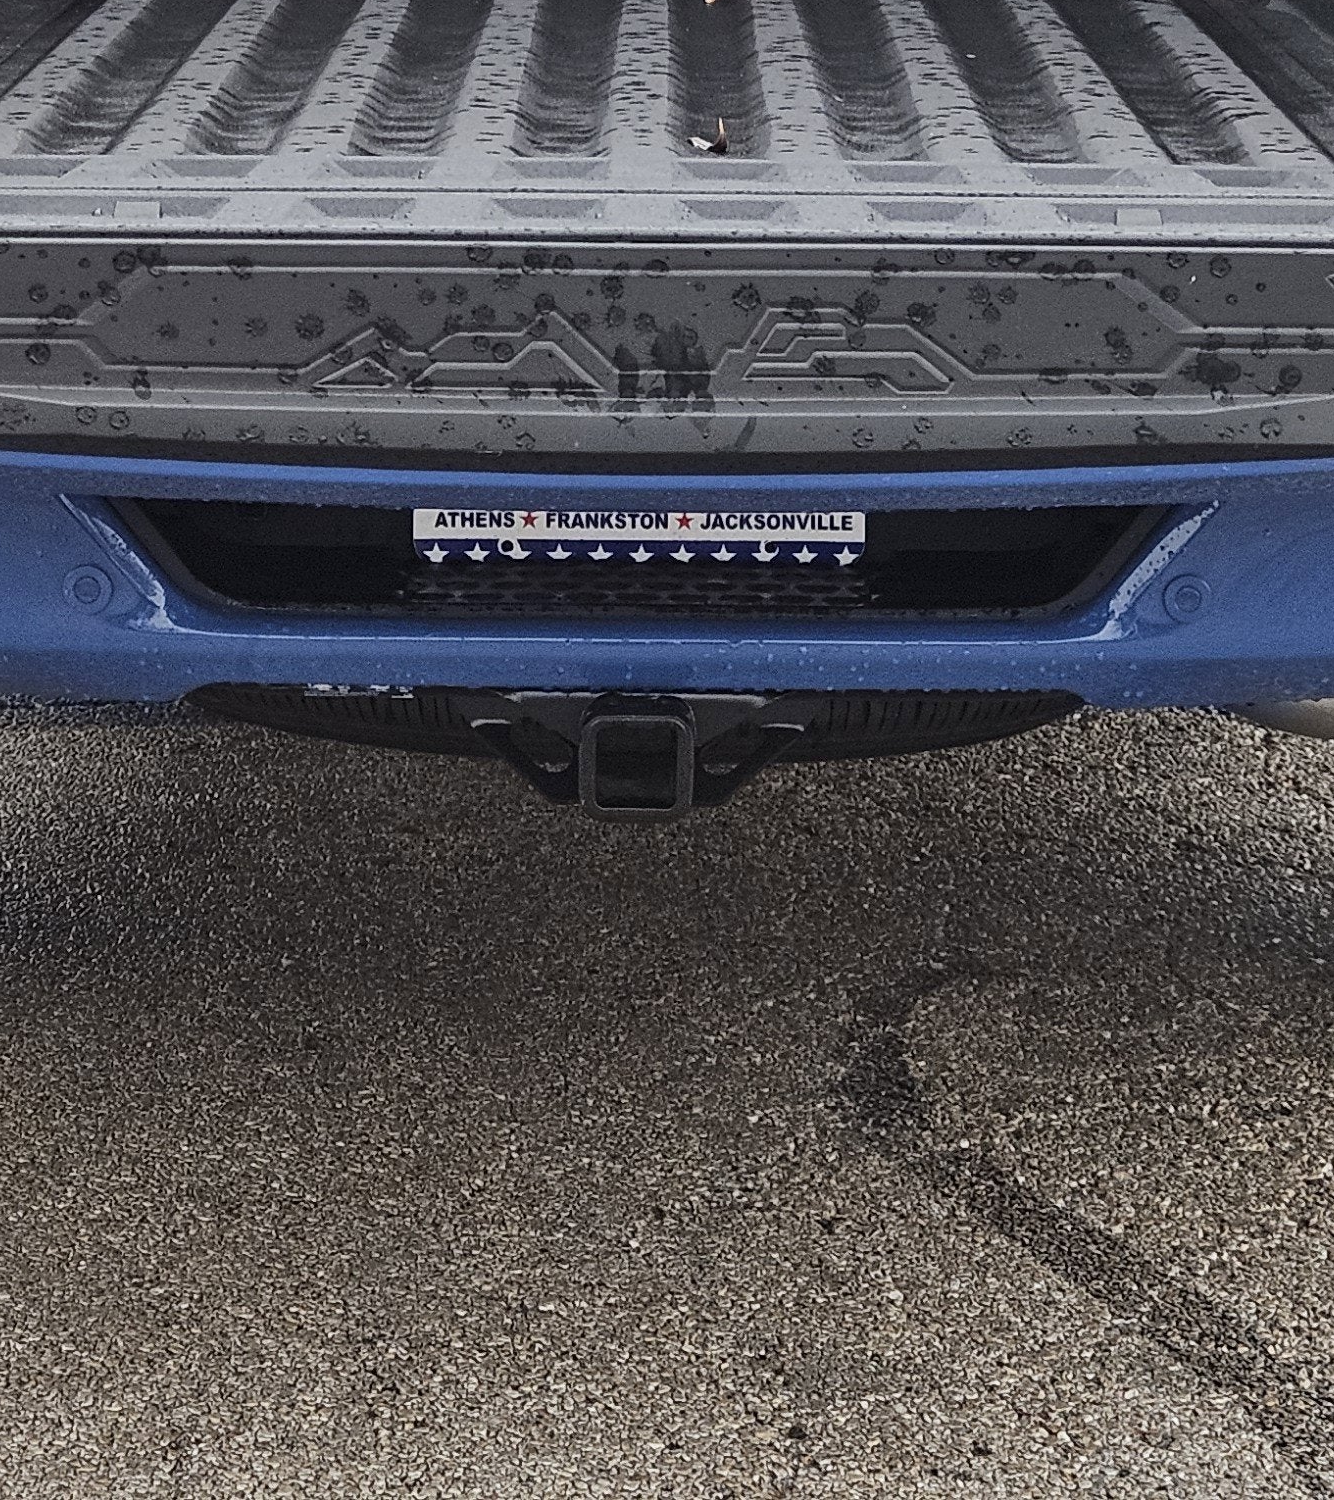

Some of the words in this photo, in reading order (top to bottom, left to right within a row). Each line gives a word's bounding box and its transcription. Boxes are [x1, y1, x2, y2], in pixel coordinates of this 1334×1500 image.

[434, 511, 516, 529] ATHENS
[545, 512, 669, 530] FRANKSTON
[700, 513, 854, 532] JACKSONVILLE
